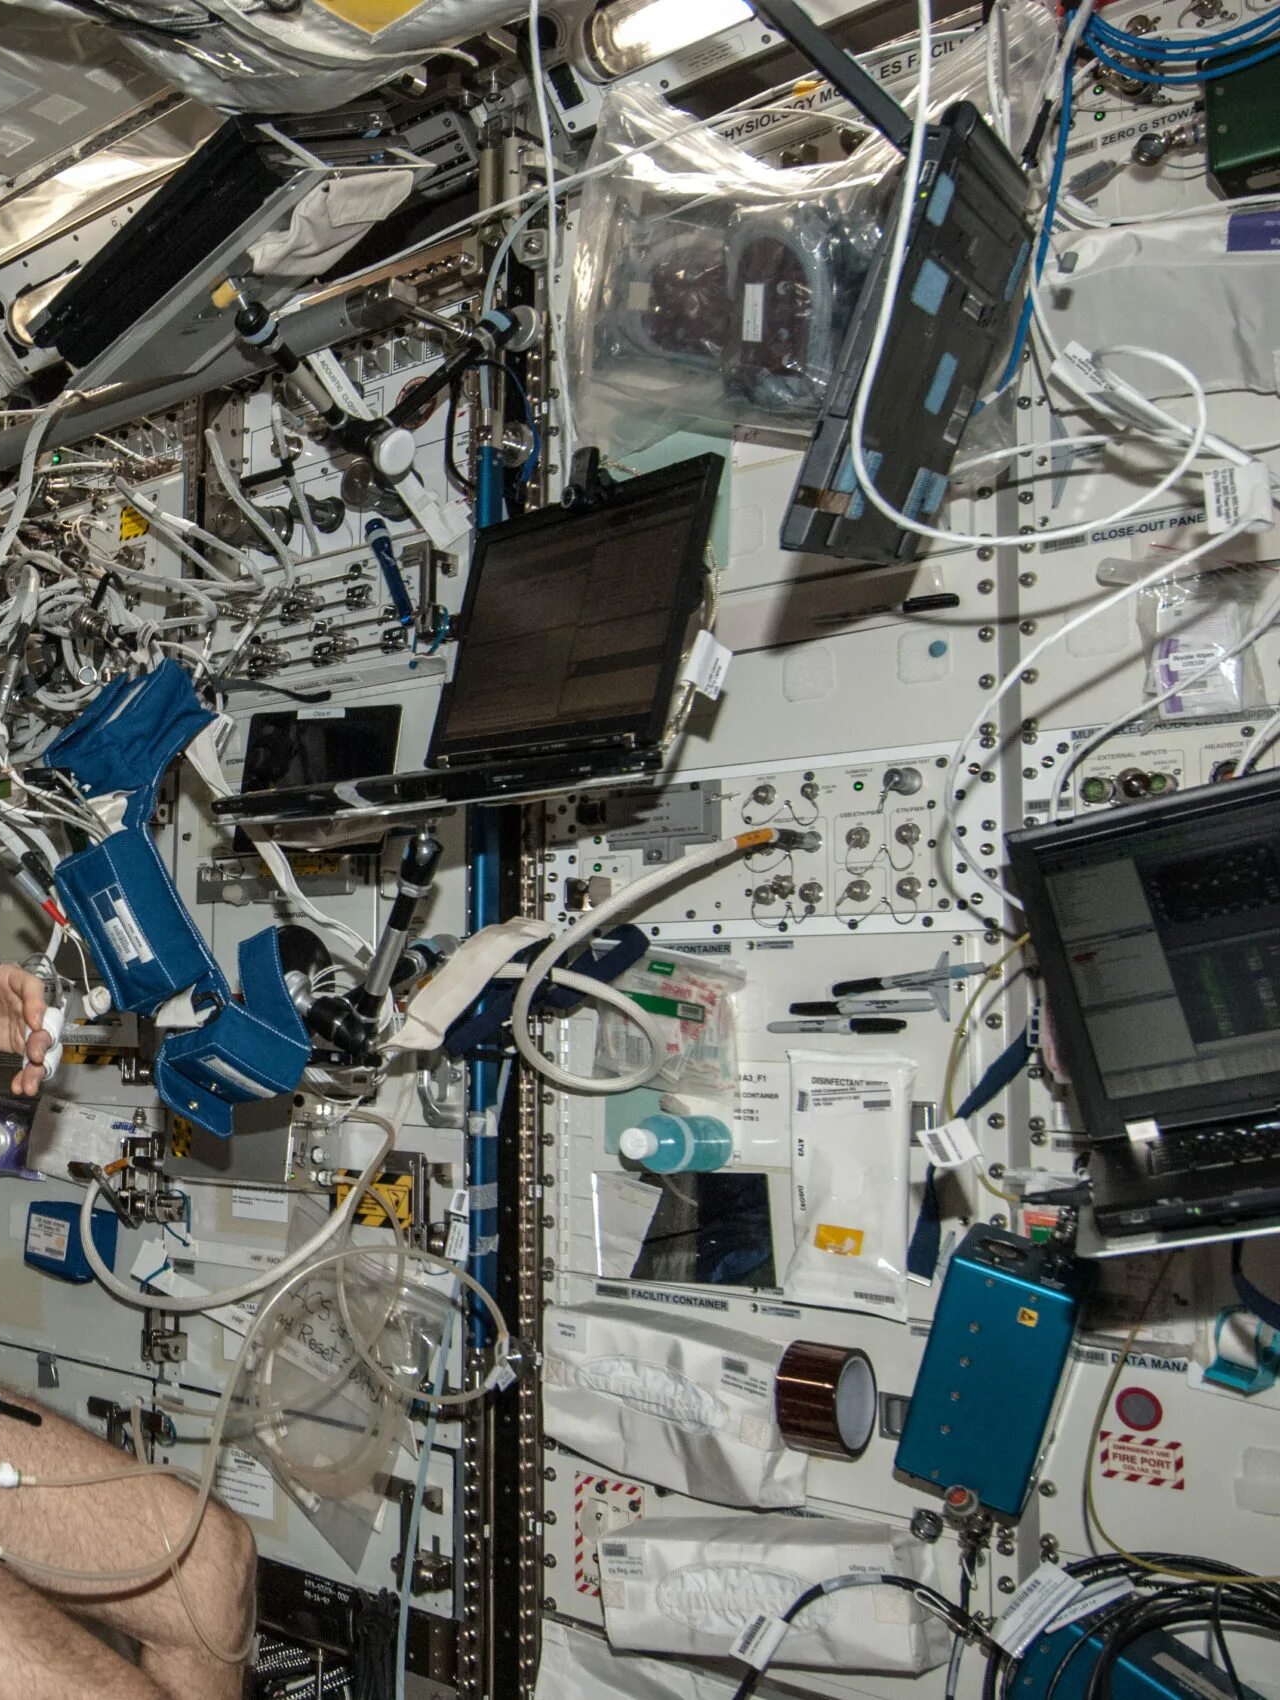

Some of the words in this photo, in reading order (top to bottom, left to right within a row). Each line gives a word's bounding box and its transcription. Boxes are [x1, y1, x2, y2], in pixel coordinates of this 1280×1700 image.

[719, 92, 816, 143] HYSIOLOGY
[1101, 128, 1136, 146] ZERO
[1138, 123, 1148, 134] G
[1152, 106, 1201, 129] STOWA
[1091, 518, 1167, 545] CLOSE-OUT
[1169, 512, 1206, 530] PANE
[676, 942, 731, 954] CONTAINER
[811, 1076, 865, 1088] DISINFECTANT
[631, 1289, 670, 1303] FACILITY
[672, 1294, 729, 1312] CONTAINER
[298, 1322, 341, 1363] Reset
[1151, 1358, 1189, 1373] MANA
[1113, 1444, 1154, 1456] EMERGENCY
[1156, 1450, 1170, 1458] USE
[1112, 1453, 1137, 1464] FIRE
[1140, 1457, 1172, 1469] PORT
[583, 1574, 600, 1587] RAC
